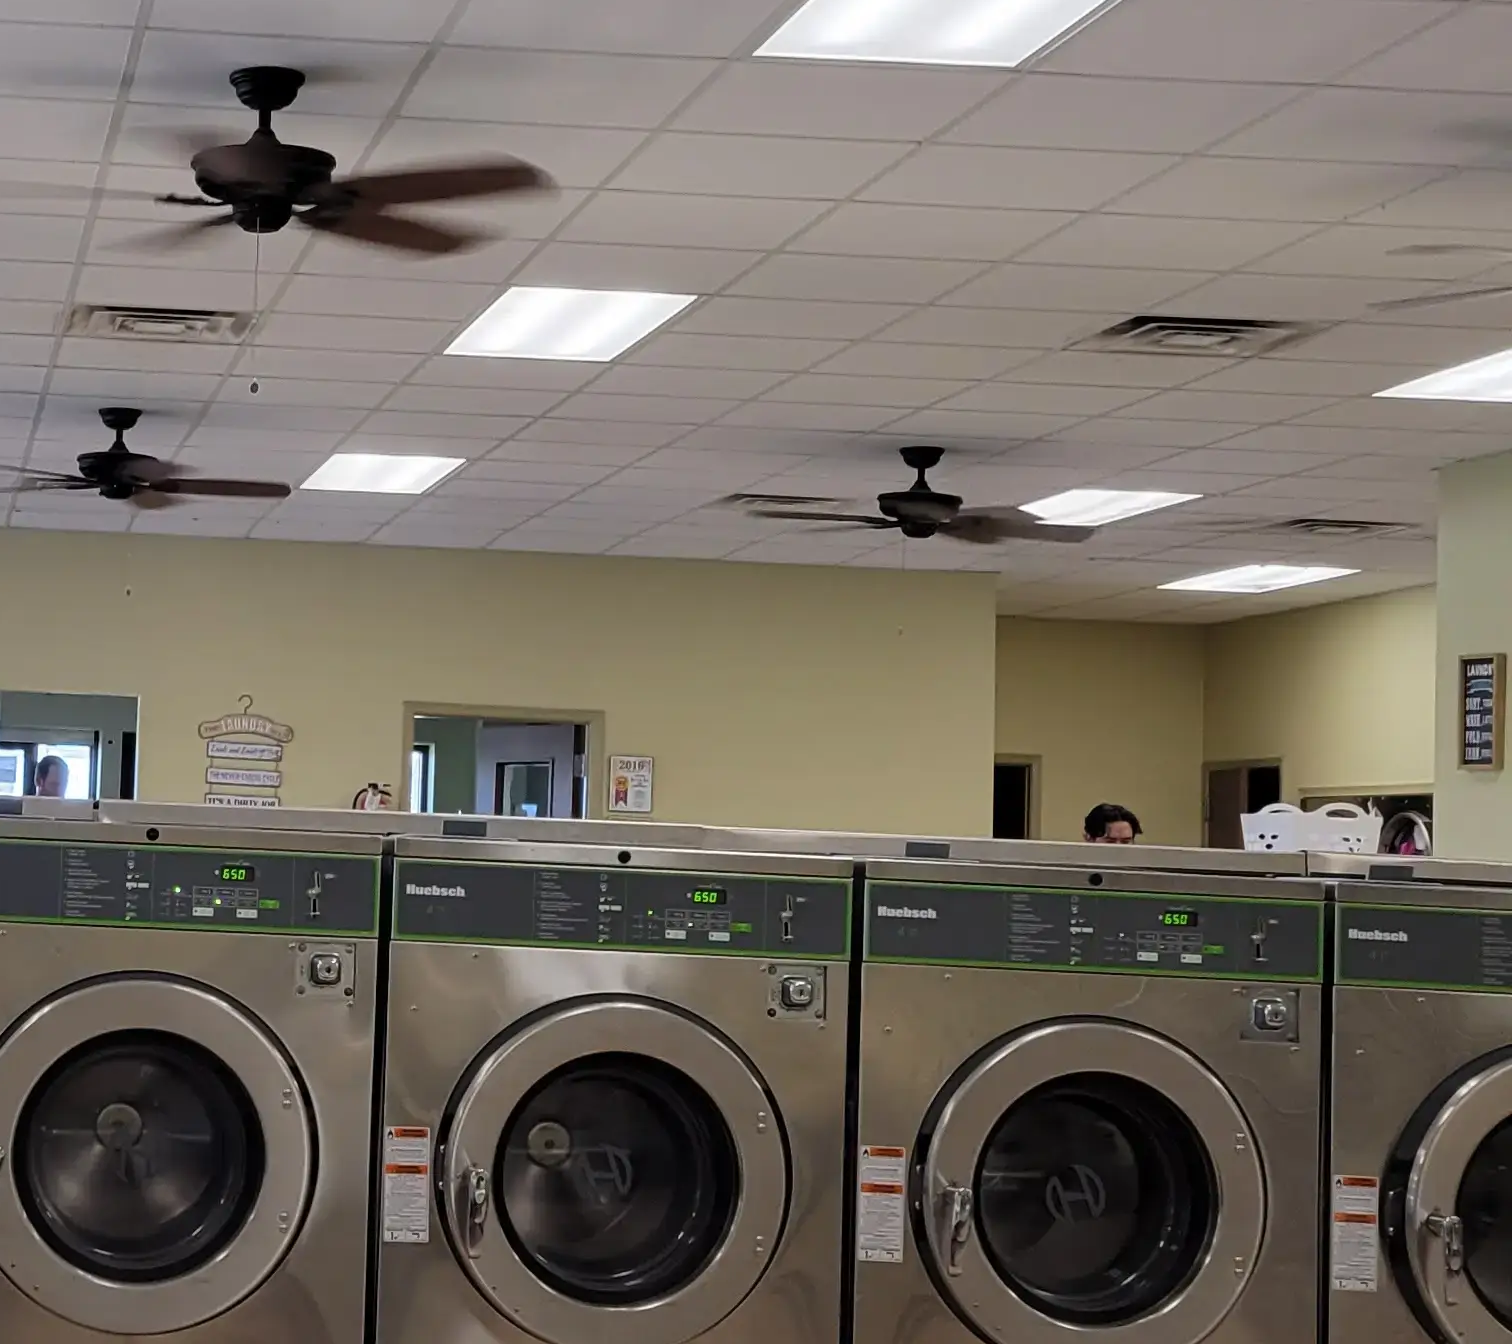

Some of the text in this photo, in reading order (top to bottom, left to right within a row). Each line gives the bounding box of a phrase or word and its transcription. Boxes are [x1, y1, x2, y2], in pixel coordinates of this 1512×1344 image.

[221, 717, 272, 732] LAUNDRY
[222, 868, 246, 880] 650
[405, 883, 466, 897] Huebsch
[693, 891, 717, 903] 650
[877, 905, 937, 919] Huebsch
[1164, 913, 1188, 925] 650
[1348, 928, 1408, 942] Huebsch
